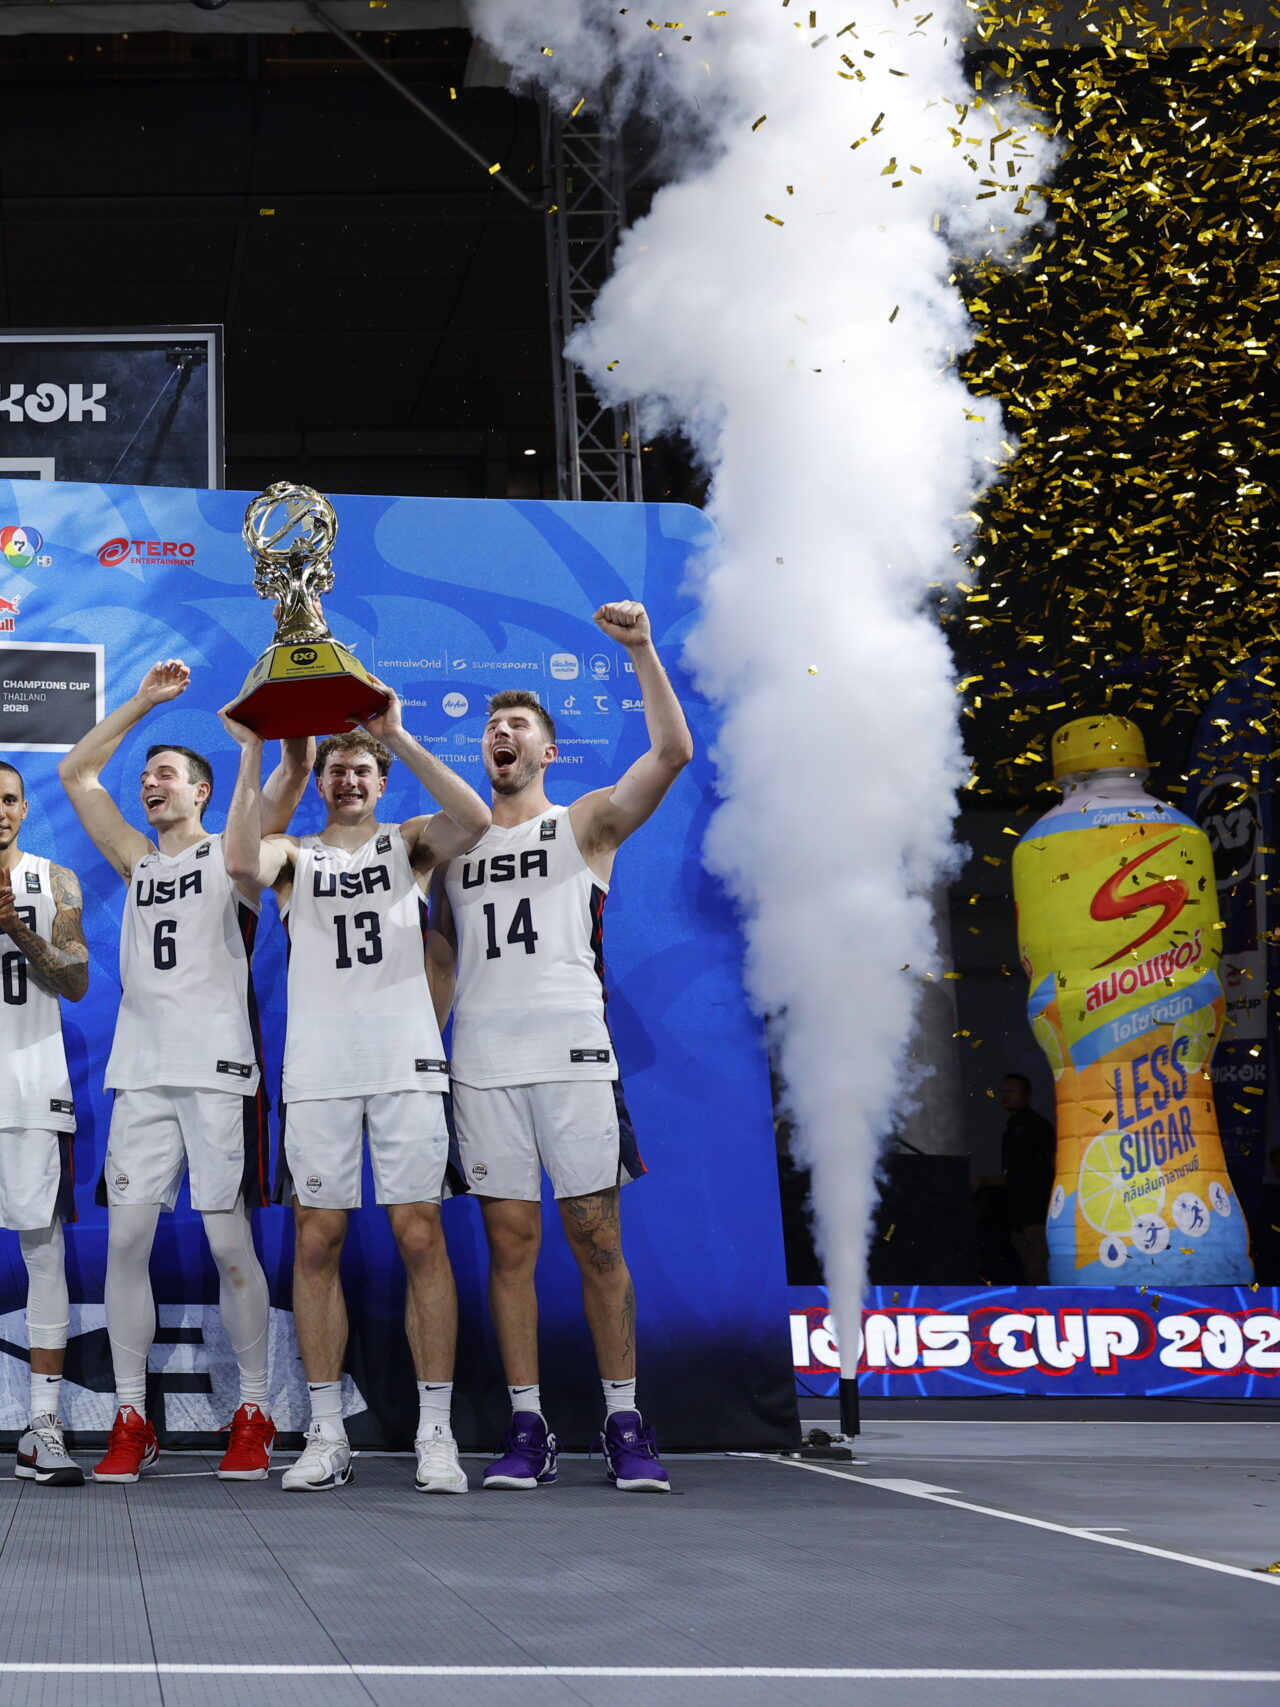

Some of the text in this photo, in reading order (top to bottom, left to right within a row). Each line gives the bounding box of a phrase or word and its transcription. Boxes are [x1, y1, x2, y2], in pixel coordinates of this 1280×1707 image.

[131, 540, 195, 557] TERO
[131, 558, 195, 567] ENTERTAINMENT
[472, 661, 538, 670] SUPERSPORTS
[3, 680, 90, 691] CHAMPIONS CUP
[3, 692, 46, 701] THAILAND
[3, 704, 29, 712] 2026
[424, 735, 448, 744] Sports
[555, 738, 609, 746] rosportsevents
[469, 755, 480, 763] OF
[313, 864, 391, 899] USA
[462, 849, 549, 890] USA
[136, 869, 202, 907] USA
[153, 919, 178, 970] 6
[333, 910, 383, 969] 13
[483, 898, 539, 960] 14
[1085, 928, 1203, 1012] สปอนเซอร์
[1114, 1035, 1189, 1130] LESS
[1120, 1105, 1196, 1181] SUGAR
[988, 1313, 1139, 1368] CUP
[1157, 1314, 1280, 1369] 202
